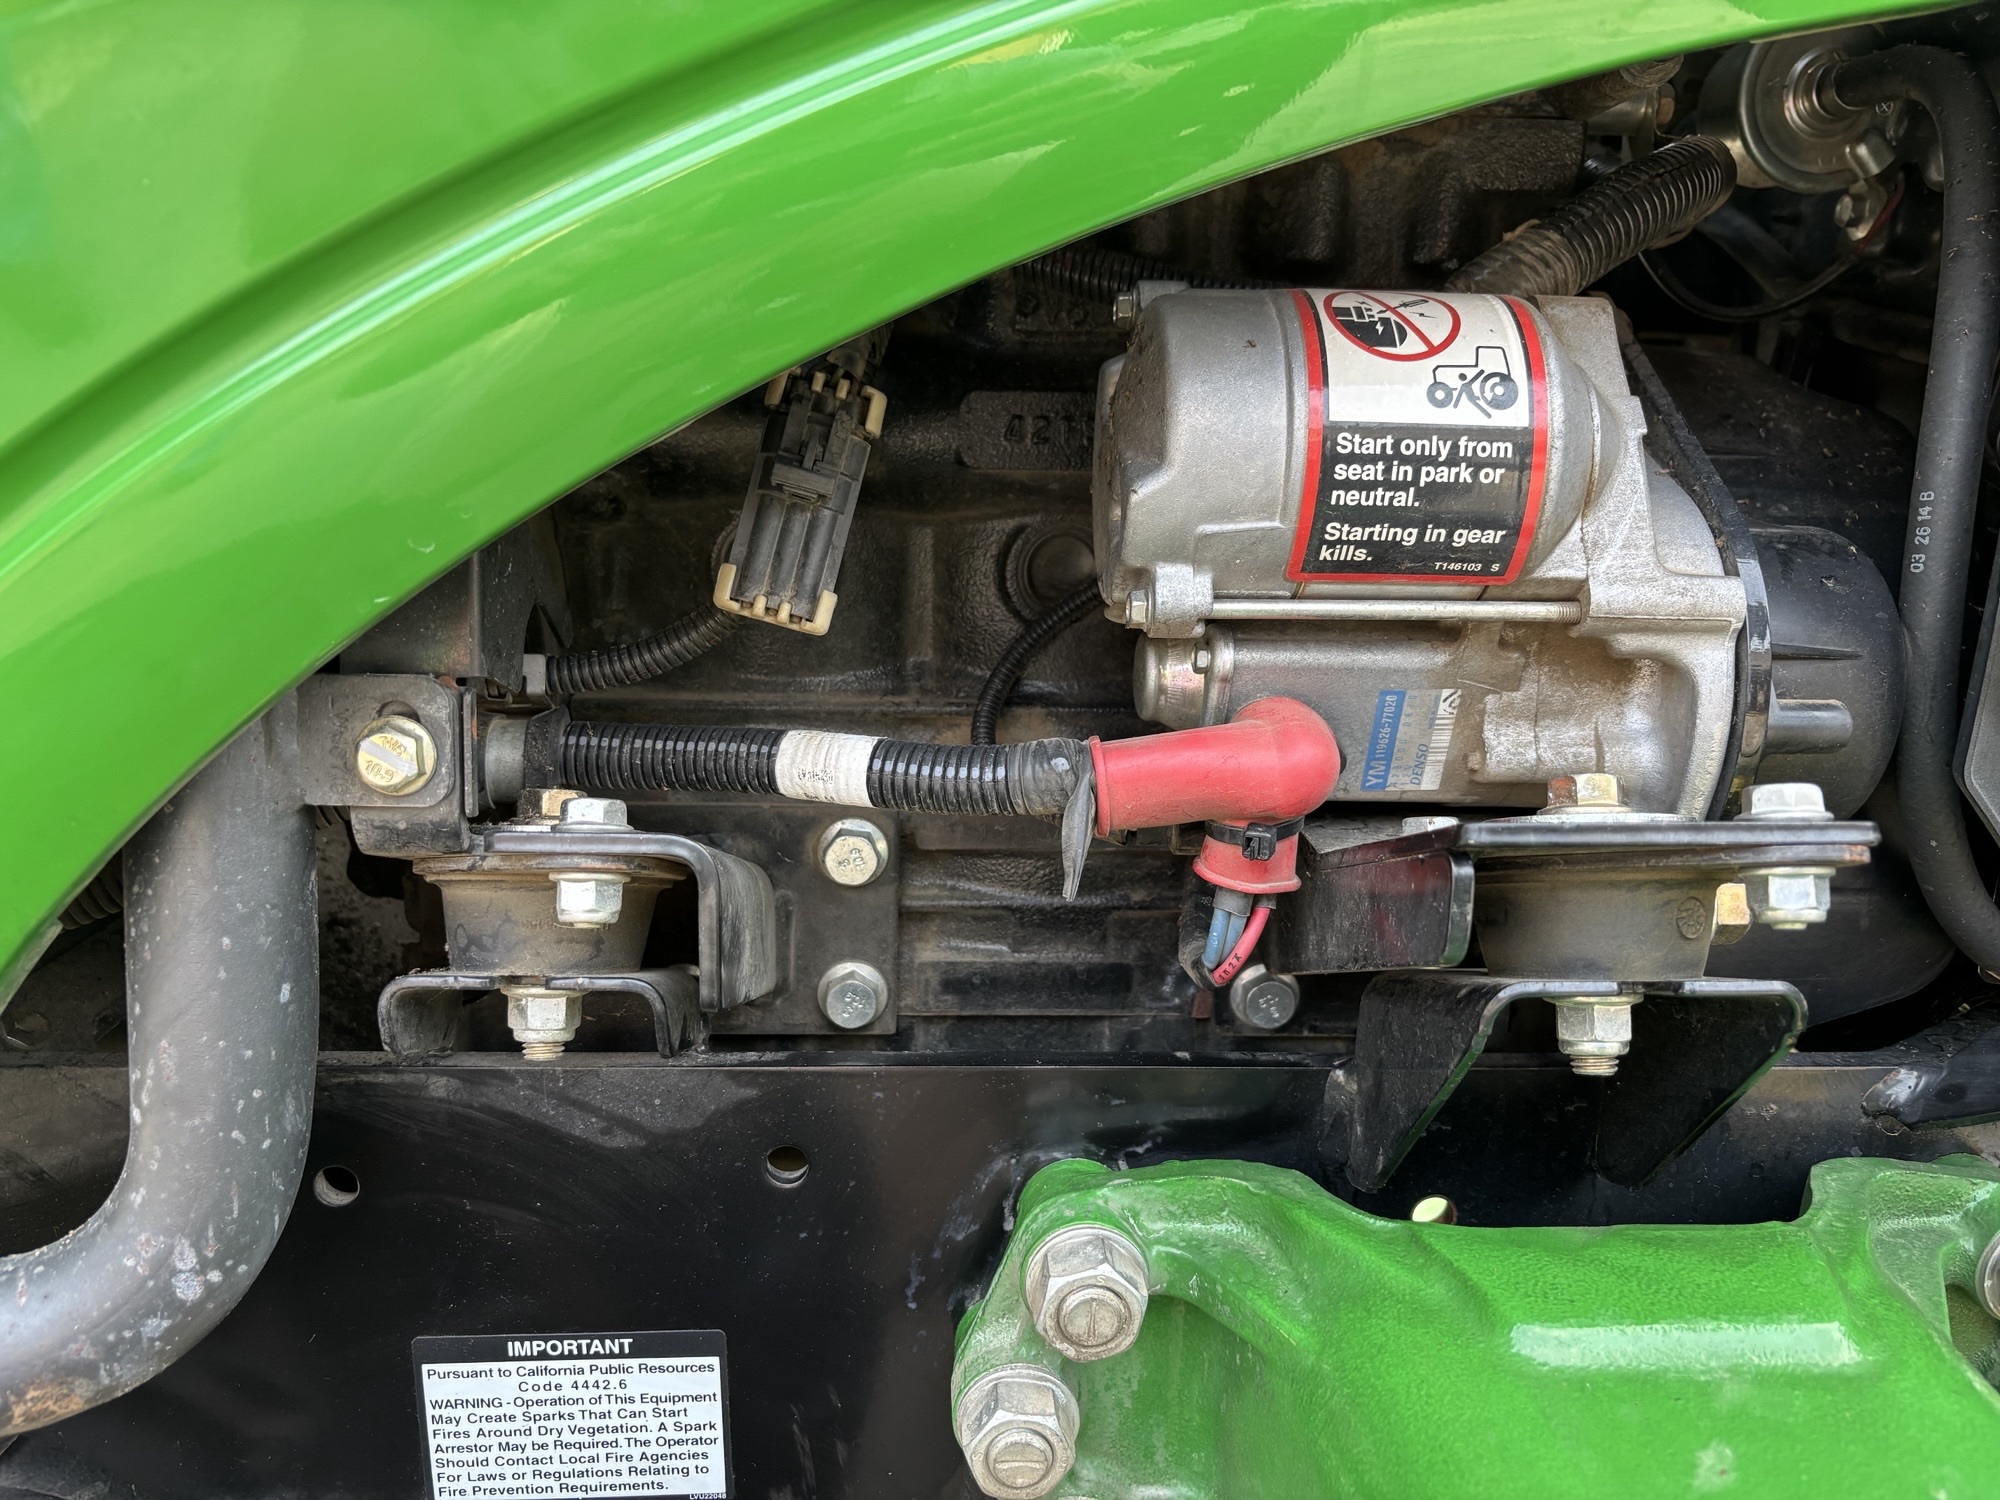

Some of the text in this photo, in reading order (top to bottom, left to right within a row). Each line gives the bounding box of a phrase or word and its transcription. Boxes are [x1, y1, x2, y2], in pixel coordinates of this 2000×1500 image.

[1336, 431, 1513, 461] Start only from
[1333, 461, 1505, 487] seat in park or
[1330, 487, 1420, 507] neutral.
[1324, 521, 1507, 547] Starting in gear
[1910, 491, 1935, 573] 03 26 14 B
[1318, 545, 1373, 561] kills.
[1434, 562, 1500, 572] T146103 S
[1365, 694, 1398, 787] YM 119626-77020
[1410, 743, 1428, 786] DENSO
[507, 1338, 633, 1357] IMPORTANT
[427, 1362, 715, 1380] Pursuant to California Public Resources
[518, 1379, 627, 1392] Code 4442.6
[430, 1397, 503, 1410] WARNING
[513, 1395, 585, 1410] Operation
[588, 1394, 602, 1406] of
[604, 1393, 636, 1405] This
[640, 1391, 717, 1406] Equipment
[431, 1407, 688, 1427] May Create Sparks That Can Start
[433, 1420, 717, 1440] Fires Around Dry Vegetation. A Spark
[434, 1435, 719, 1454] Arrestor May be Required. The Operator
[435, 1450, 709, 1469] Should Contact Local Fire Agencies
[437, 1464, 710, 1483] For Laws or Regulations Relating to
[438, 1480, 669, 1498] Fire Prevention Requirements.
[689, 1492, 727, 1500] LVU22048
